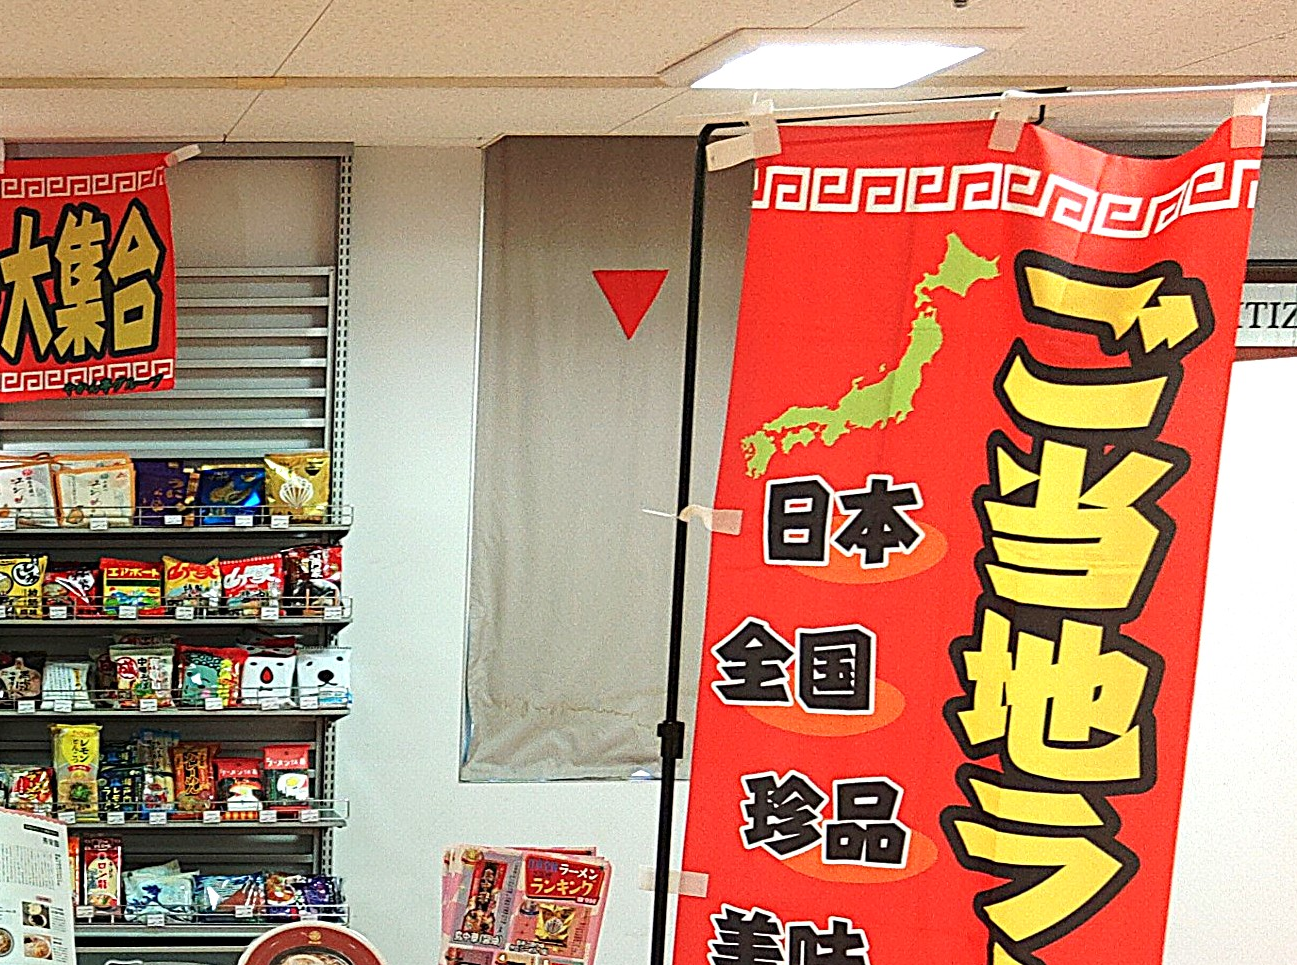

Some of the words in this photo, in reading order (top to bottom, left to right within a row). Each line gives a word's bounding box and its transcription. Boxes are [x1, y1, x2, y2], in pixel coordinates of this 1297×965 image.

[1239, 302, 1297, 328] TIZ
[764, 475, 923, 569] 日本
[107, 568, 160, 577] エアポート
[711, 617, 876, 714] 全国
[739, 770, 911, 867] 珍品
[559, 864, 599, 880] ラーメン
[530, 877, 596, 897] ランキング
